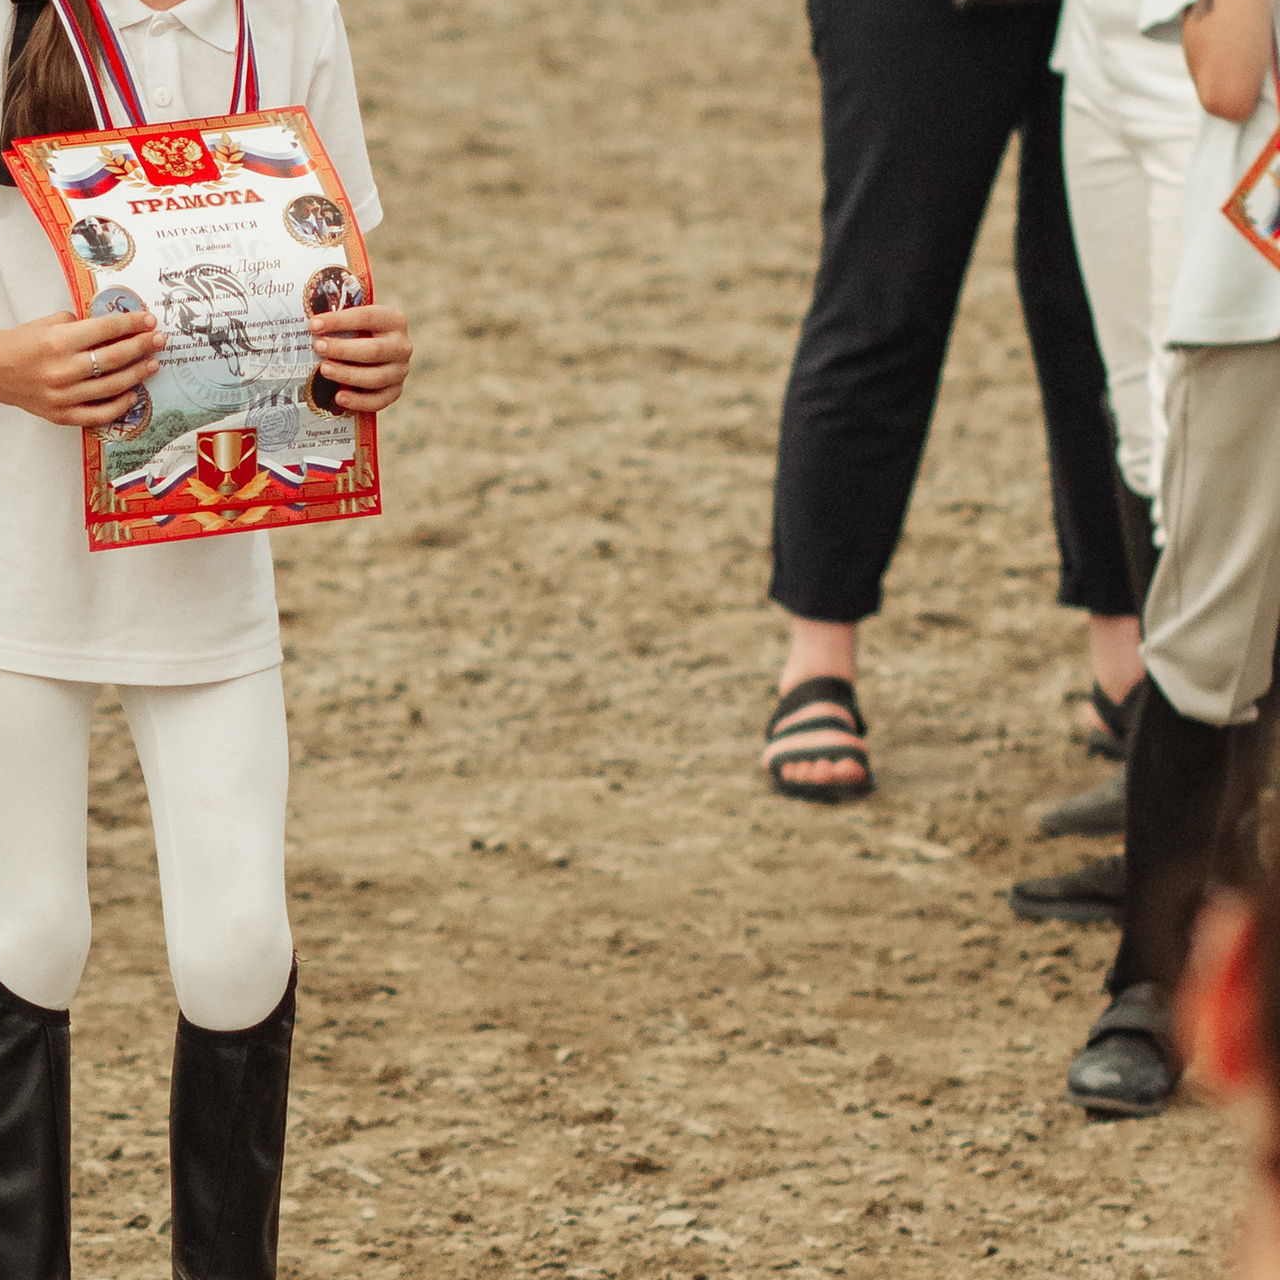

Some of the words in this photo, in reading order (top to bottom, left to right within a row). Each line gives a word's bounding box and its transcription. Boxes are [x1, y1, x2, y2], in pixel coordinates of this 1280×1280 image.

[127, 188, 266, 215] ГРАМОТА
[156, 220, 258, 239] НАГРАЖДАЕТСЯ
[195, 242, 232, 252] Всадник
[235, 258, 281, 276] Дарья
[247, 280, 295, 299] Зефир
[158, 354, 206, 366] программе
